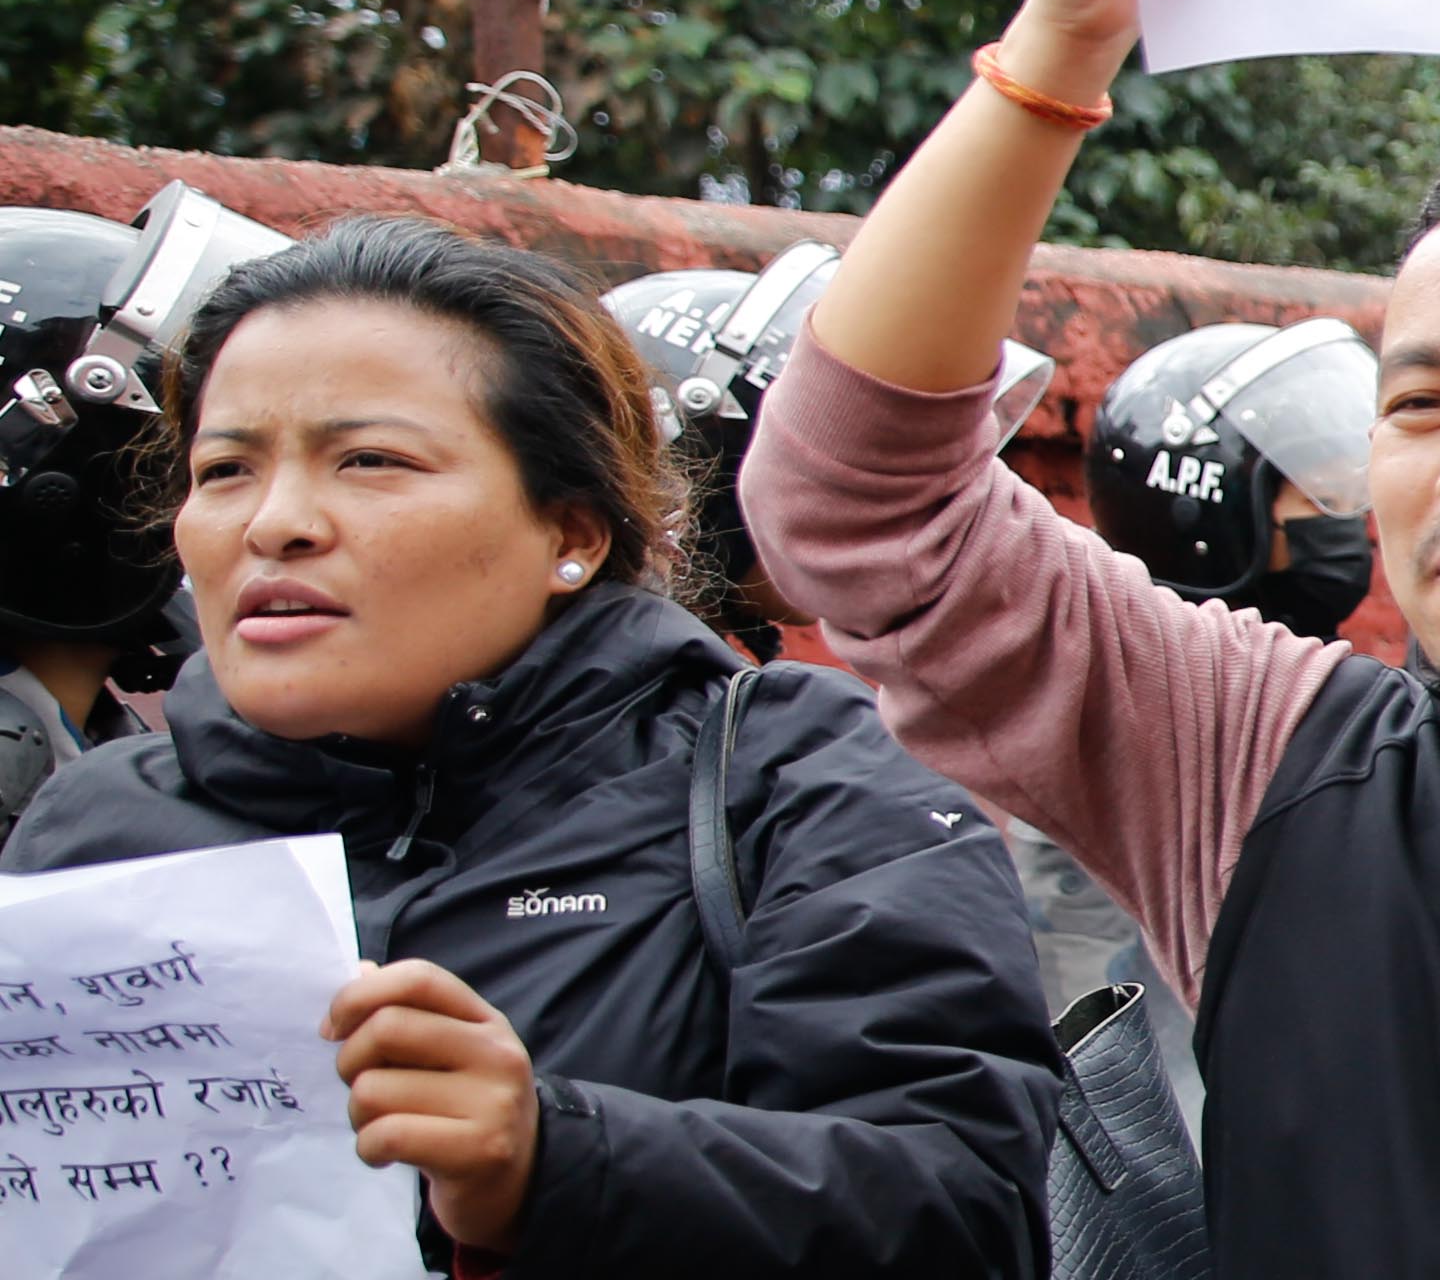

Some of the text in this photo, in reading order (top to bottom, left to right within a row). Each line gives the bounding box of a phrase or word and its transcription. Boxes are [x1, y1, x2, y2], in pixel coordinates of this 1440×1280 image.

[637, 307, 772, 391] NEPL
[1146, 449, 1227, 504] A.P.F.
[71, 941, 205, 1007] शुवर्ण
[83, 1023, 236, 1054] नाममा
[0, 1069, 166, 1136] ालुहरुको
[61, 1160, 164, 1201] सम्म
[184, 1146, 236, 1188] ??
